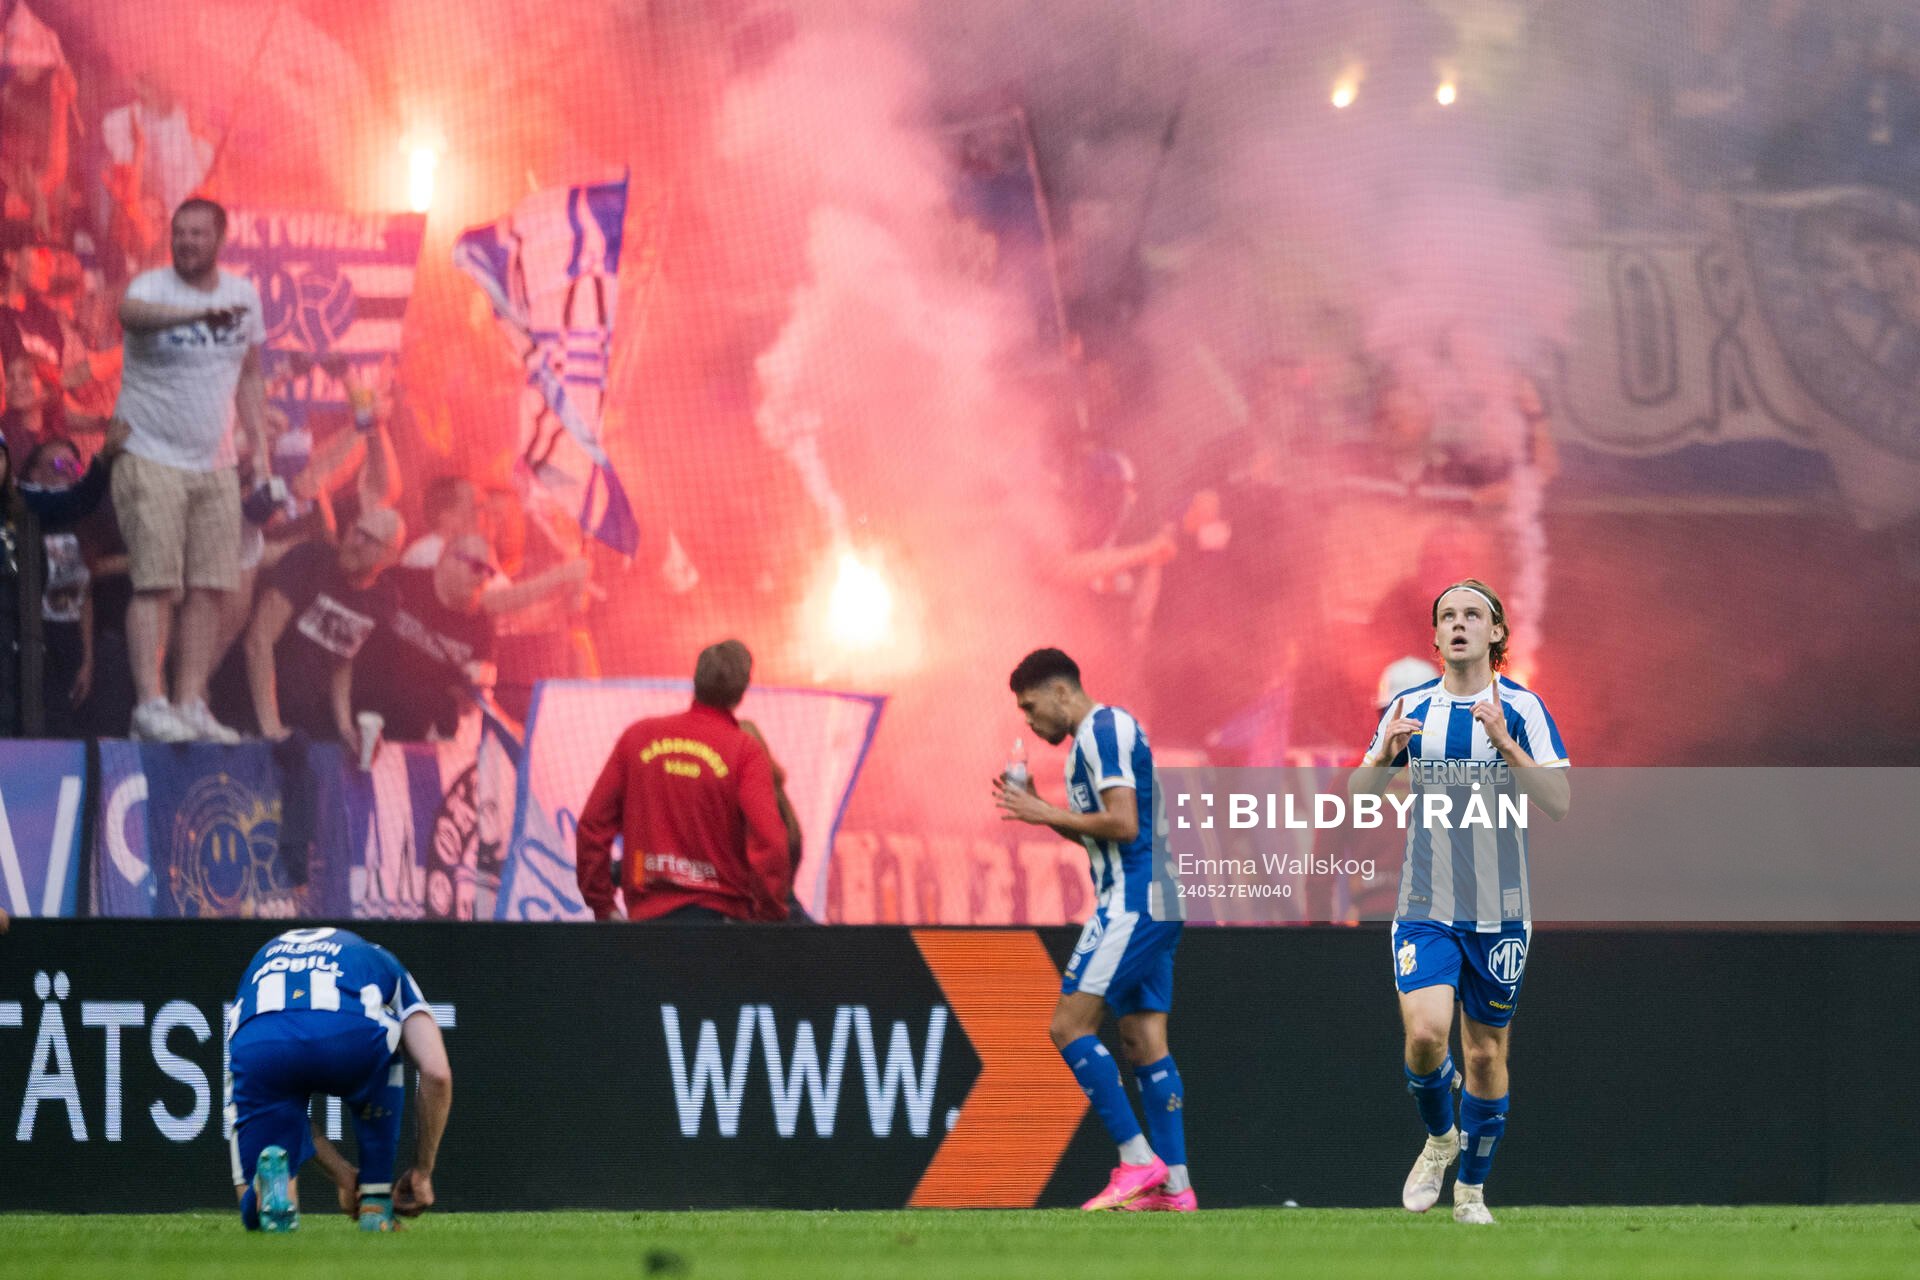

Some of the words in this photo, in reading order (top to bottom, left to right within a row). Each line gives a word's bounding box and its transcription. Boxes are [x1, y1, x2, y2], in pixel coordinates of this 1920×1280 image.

[1411, 759, 1509, 786] SERNEKE
[1491, 941, 1527, 981] MG
[1507, 984, 1517, 1002] 7
